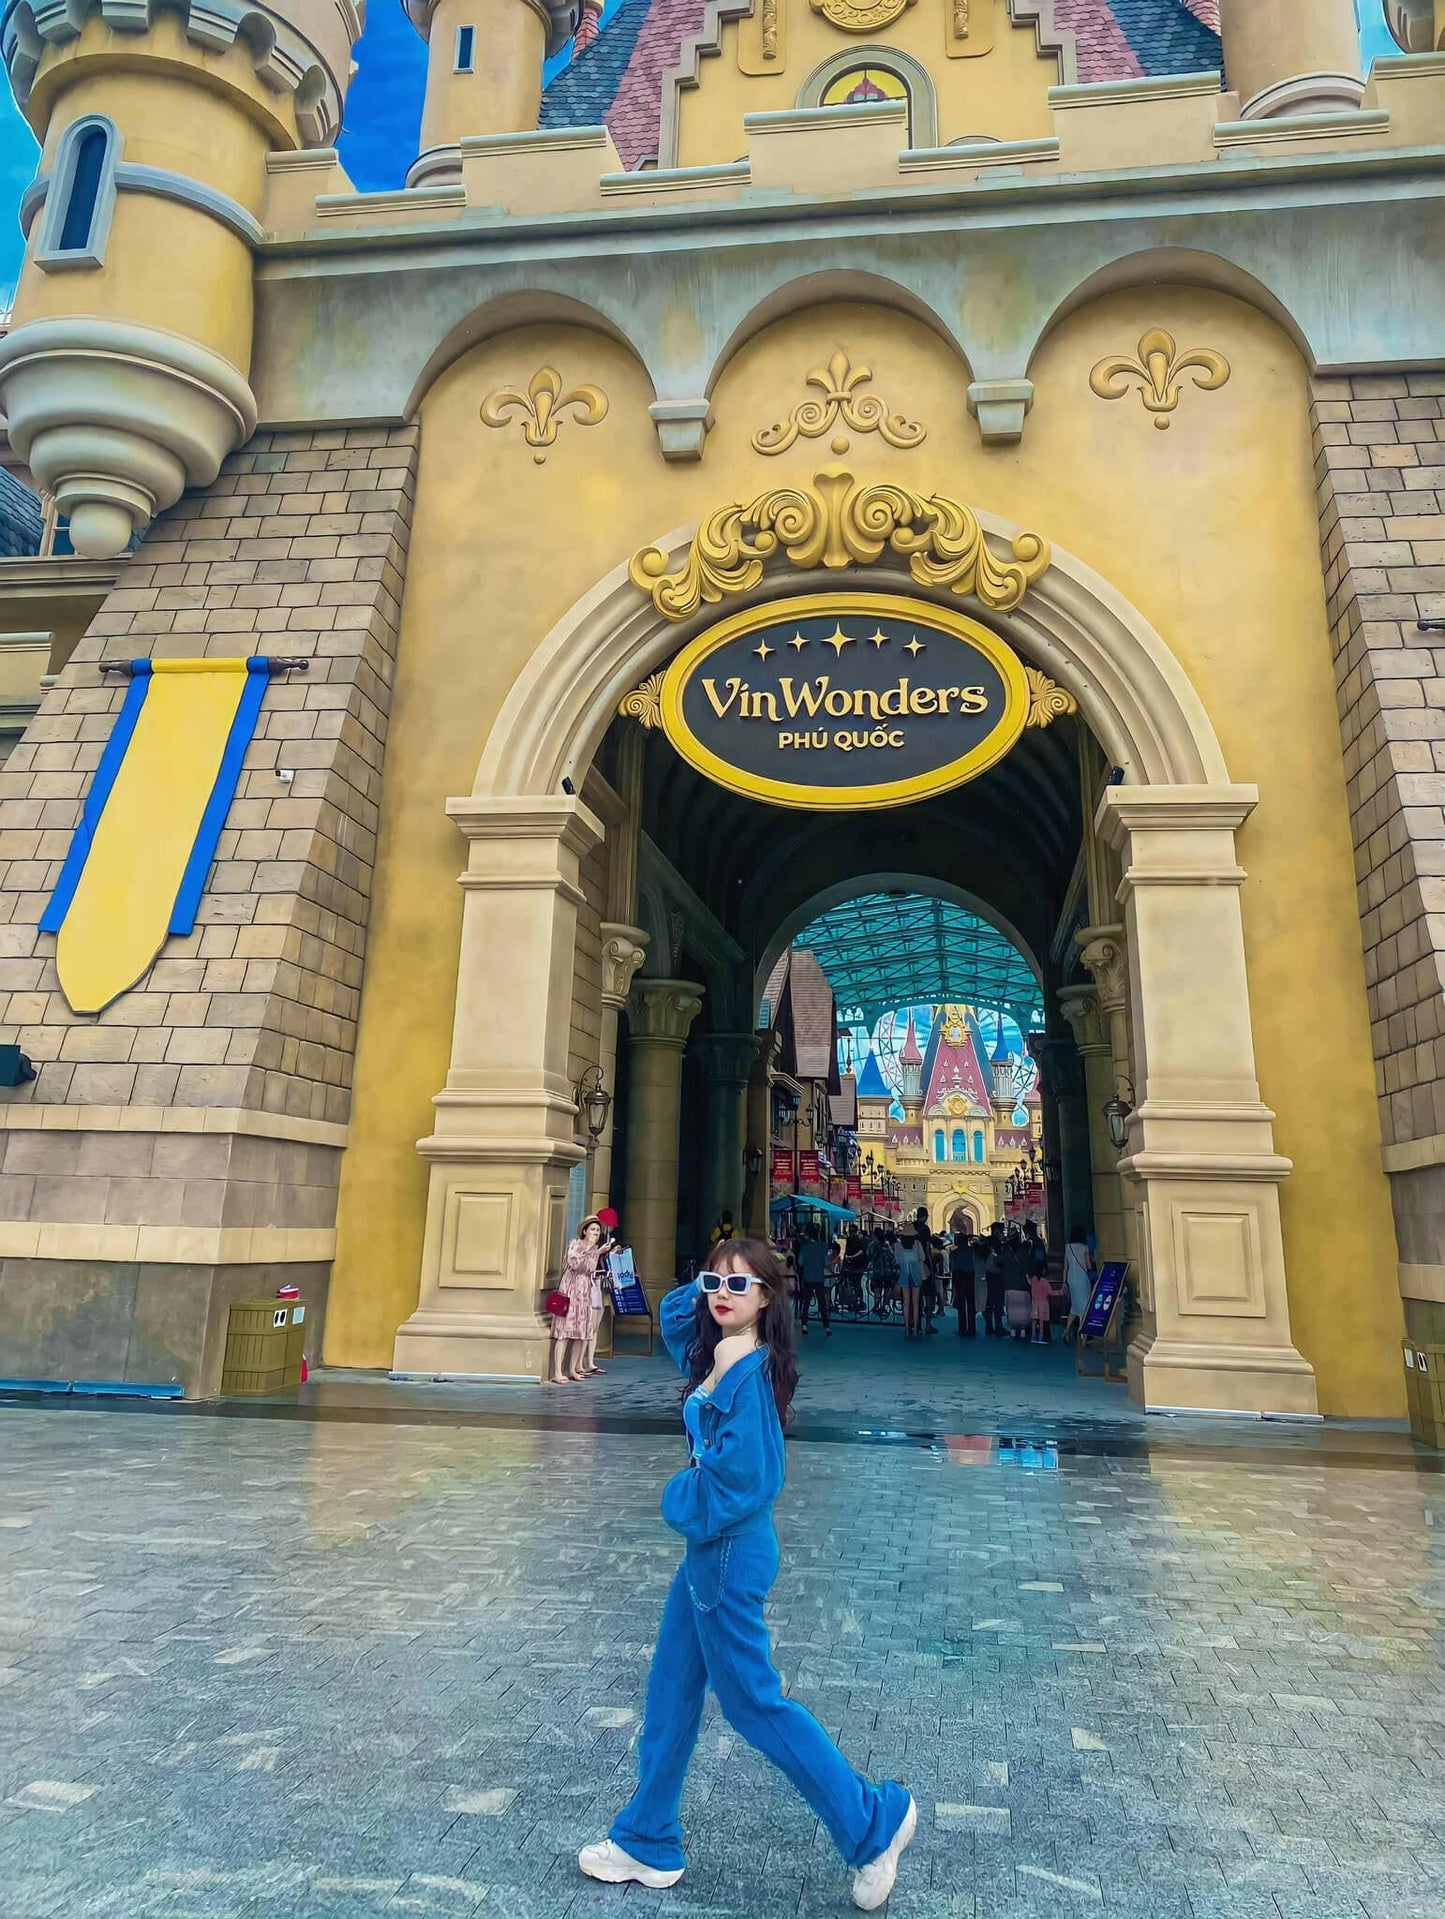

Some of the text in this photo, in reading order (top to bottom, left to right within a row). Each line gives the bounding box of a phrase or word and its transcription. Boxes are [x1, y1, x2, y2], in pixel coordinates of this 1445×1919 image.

[702, 676, 988, 721] VinWonders
[778, 723, 905, 751] PHÚ QUỐC
